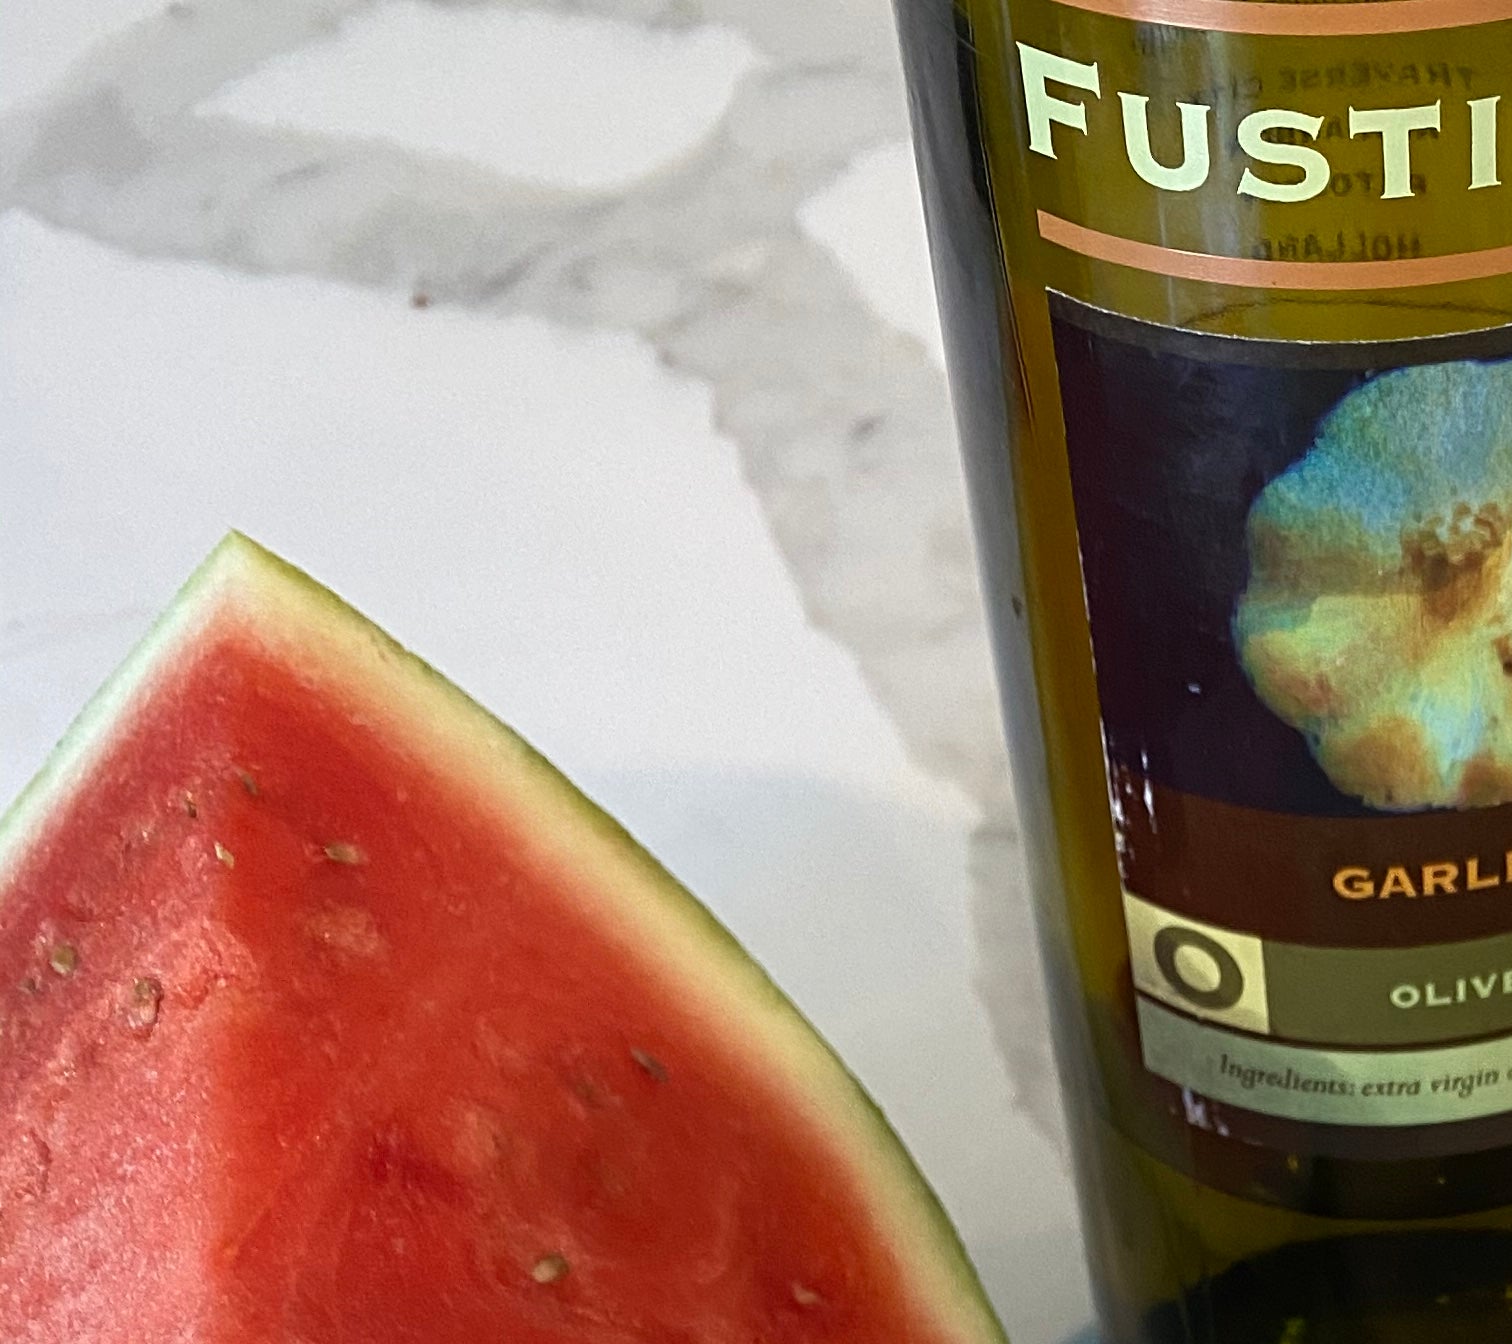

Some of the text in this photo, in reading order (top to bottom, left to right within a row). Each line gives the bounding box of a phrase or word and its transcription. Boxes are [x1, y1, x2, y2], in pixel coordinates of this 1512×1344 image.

[1154, 926, 1243, 1010] O
[1219, 1054, 1356, 1098] Ingredients:
[1361, 1077, 1421, 1098] extra
[1430, 1070, 1499, 1099] virgin
